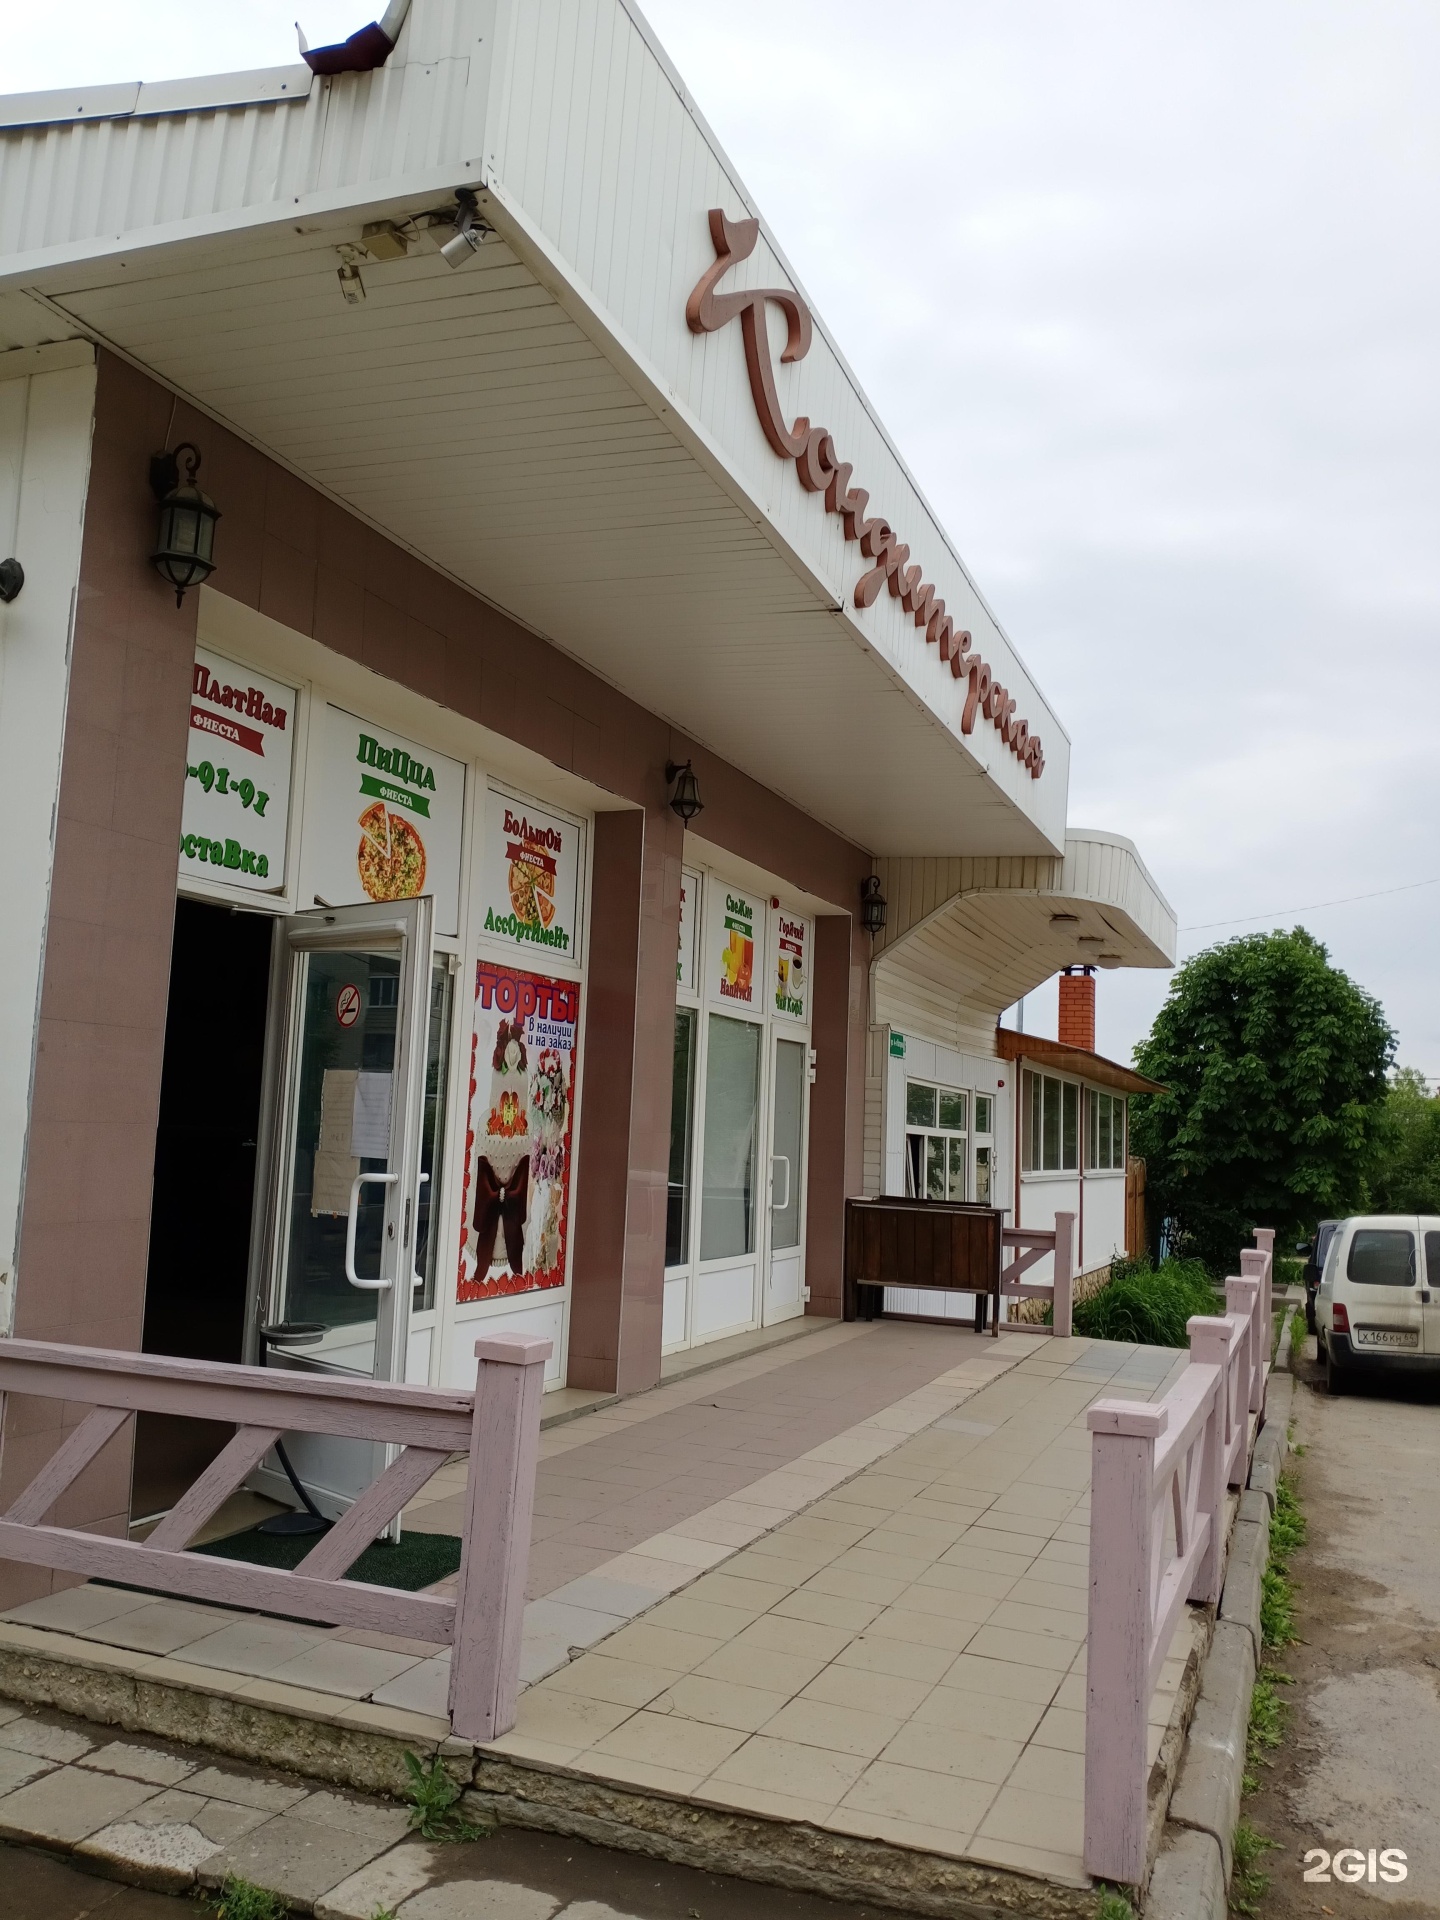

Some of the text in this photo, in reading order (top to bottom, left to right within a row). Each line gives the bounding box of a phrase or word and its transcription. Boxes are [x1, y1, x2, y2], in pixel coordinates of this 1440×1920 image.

[685, 208, 1045, 779] Кондитерская
[193, 713, 241, 742] ФИЕСТА
[185, 761, 270, 817] -91-91
[379, 786, 414, 807] ФИЕСТА
[519, 850, 545, 868] ФИЕСТА
[536, 1022, 573, 1038] наличии
[527, 1034, 572, 1051] и на заказ
